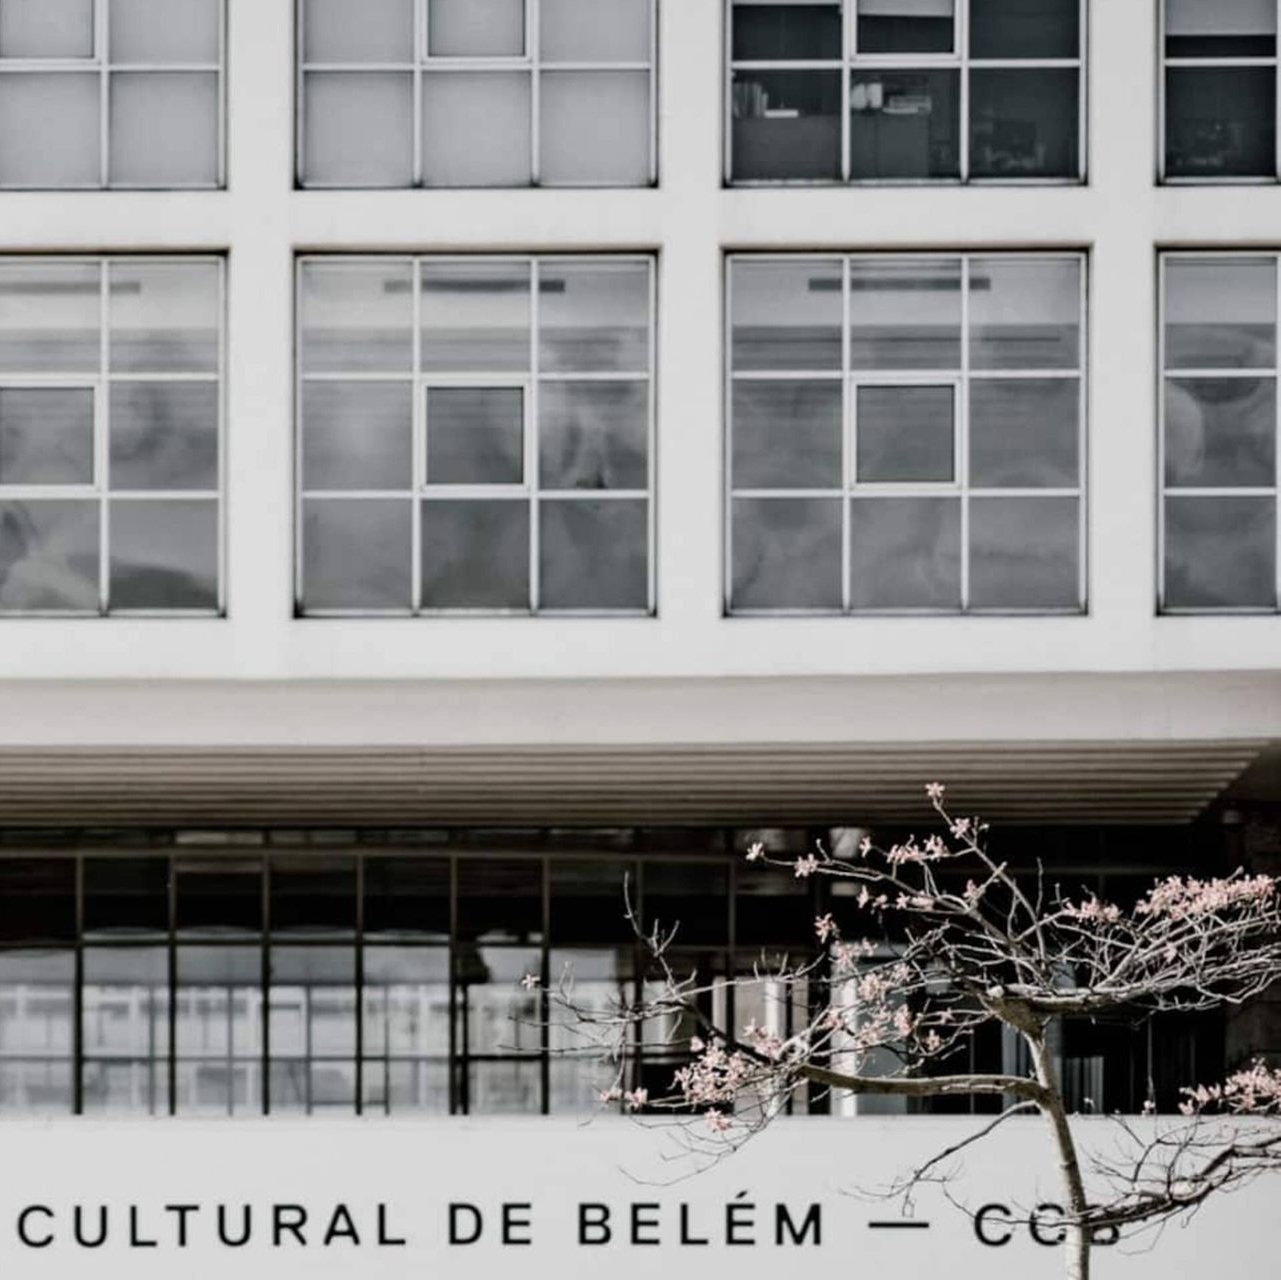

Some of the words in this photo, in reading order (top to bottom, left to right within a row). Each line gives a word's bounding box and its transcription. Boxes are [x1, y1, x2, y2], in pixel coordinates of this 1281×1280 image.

[17, 1203, 407, 1248] CULTURAL
[448, 1202, 532, 1245] DE
[578, 1190, 822, 1246] BELÉM
